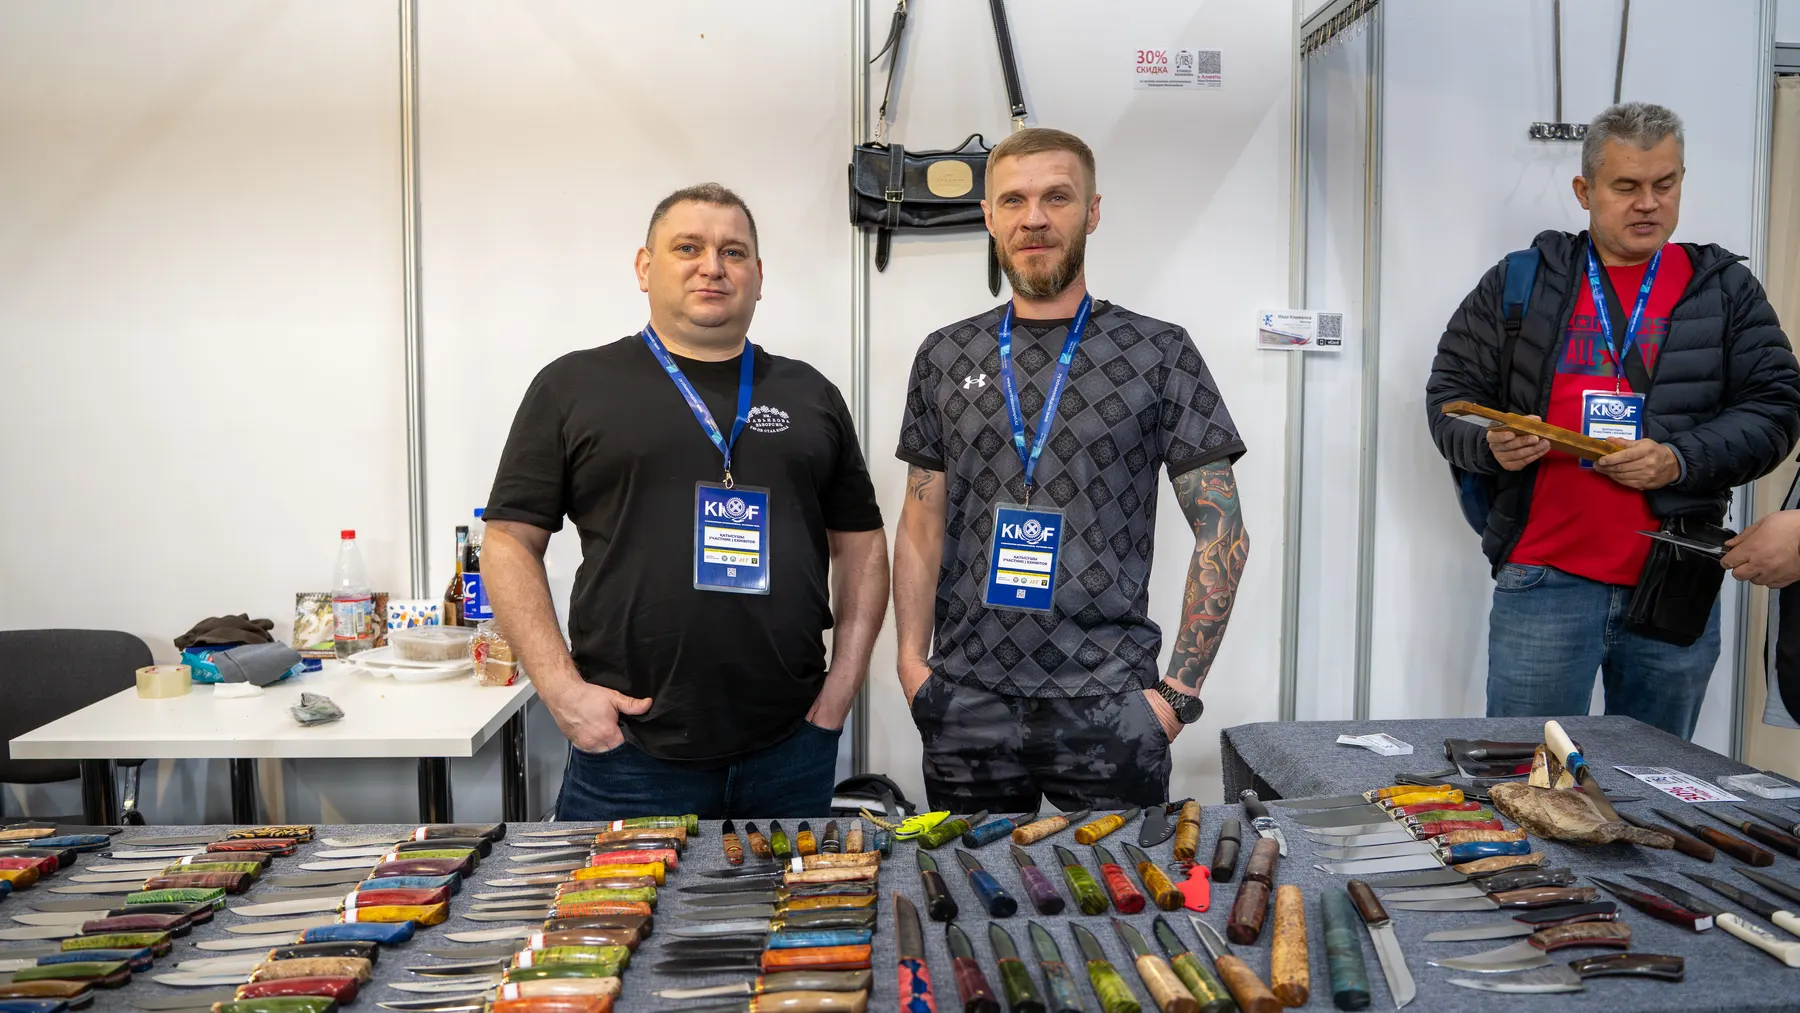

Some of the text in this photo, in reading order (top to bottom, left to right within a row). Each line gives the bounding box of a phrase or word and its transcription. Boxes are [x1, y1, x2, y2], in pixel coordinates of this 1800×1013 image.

[1136, 50, 1168, 64] 30%
[1136, 66, 1168, 74] СКИДКА
[1565, 338, 1595, 366] ALL
